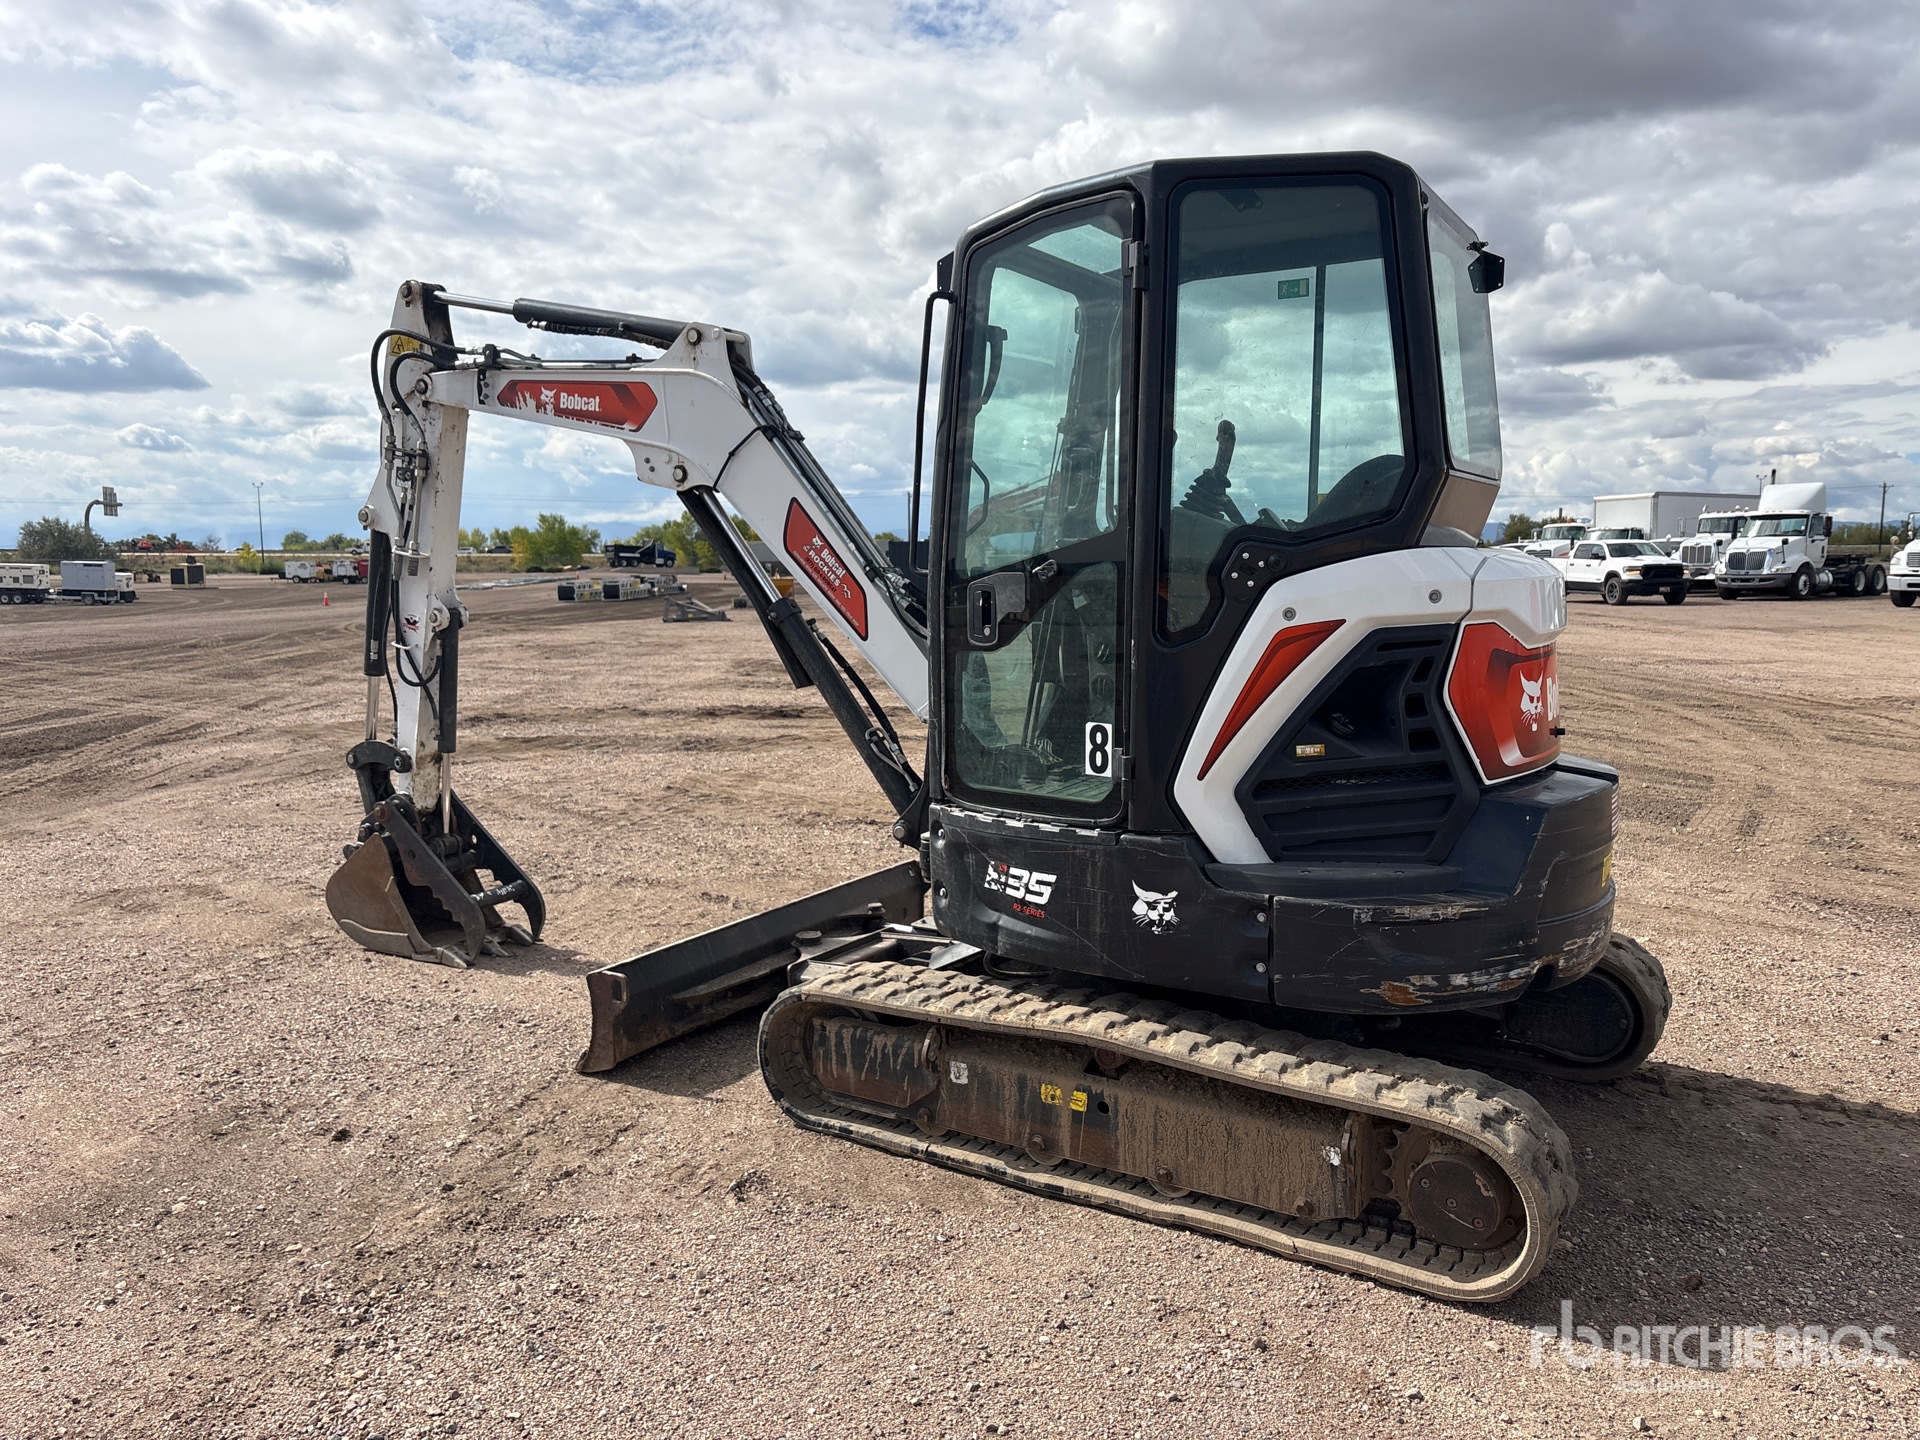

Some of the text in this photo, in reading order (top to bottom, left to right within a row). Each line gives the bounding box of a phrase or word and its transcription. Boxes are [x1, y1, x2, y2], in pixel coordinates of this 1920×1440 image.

[560, 392, 600, 412] Bobcat
[808, 550, 841, 587] ROCKIES
[819, 548, 847, 579] Bobcat
[1089, 724, 1109, 774] 8
[1013, 902, 1046, 918] R2-SERIES
